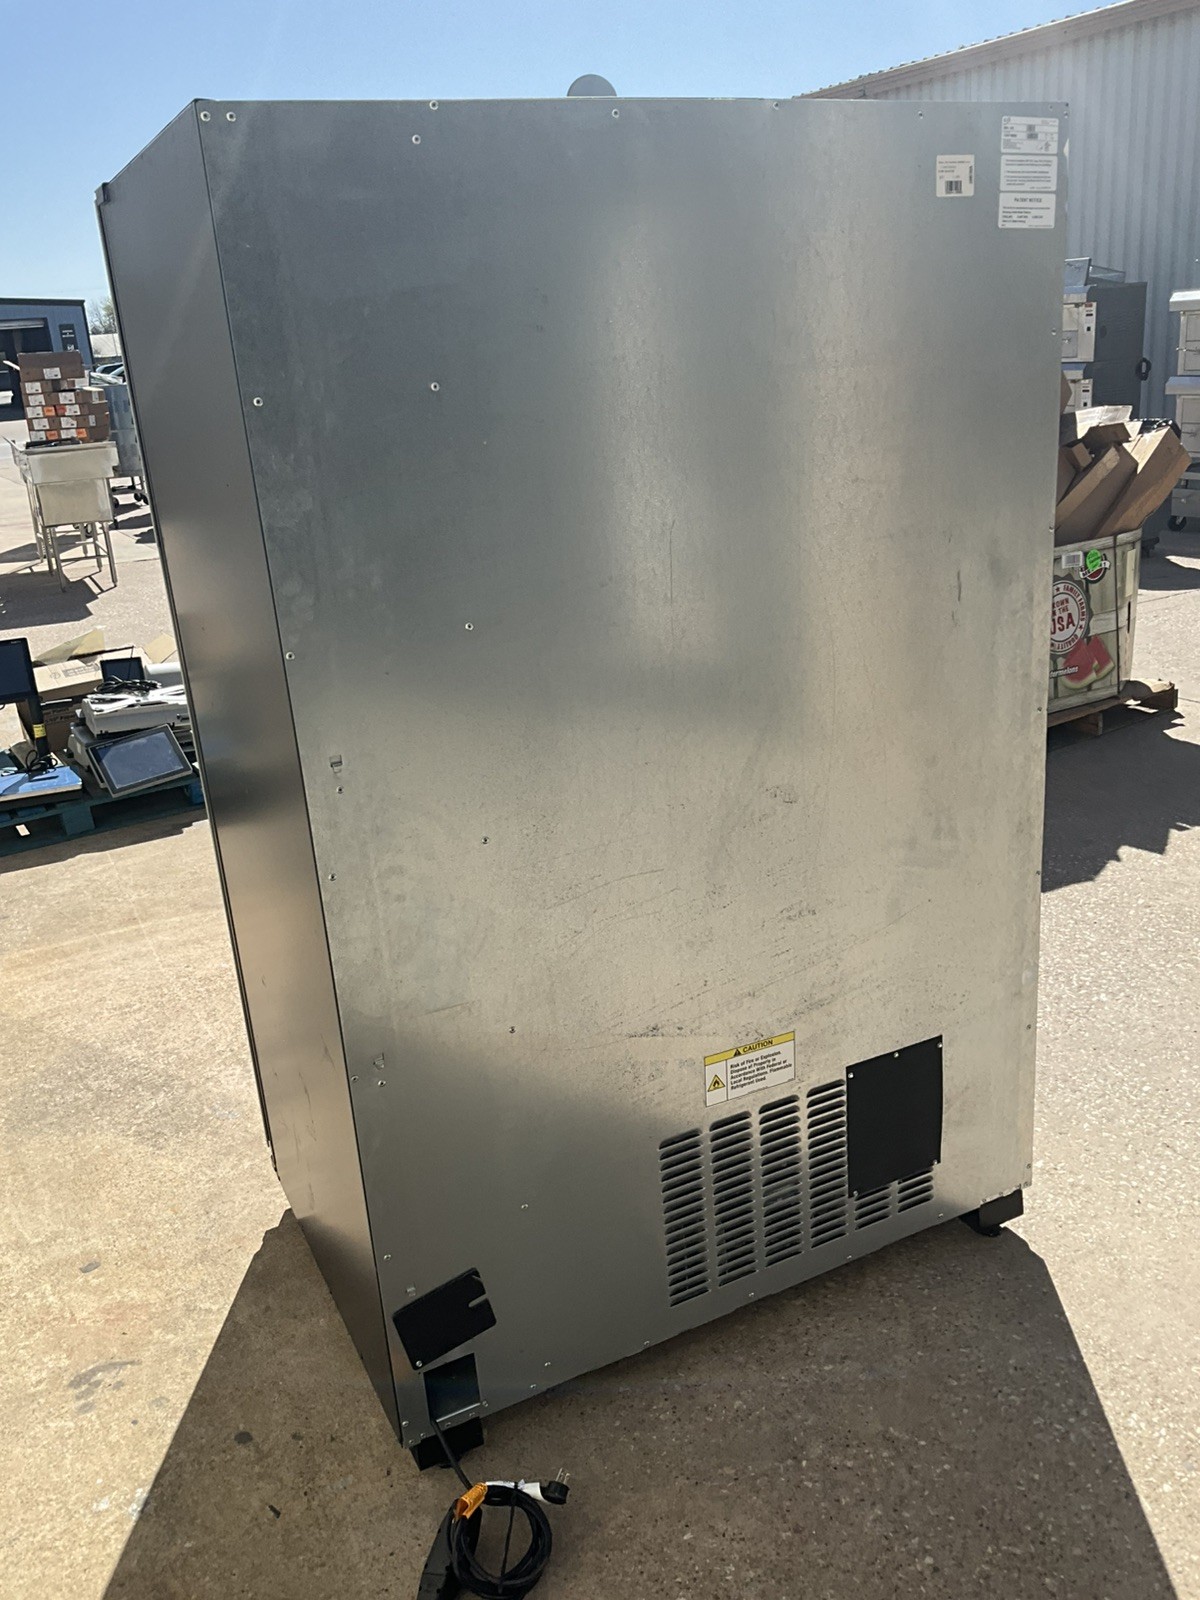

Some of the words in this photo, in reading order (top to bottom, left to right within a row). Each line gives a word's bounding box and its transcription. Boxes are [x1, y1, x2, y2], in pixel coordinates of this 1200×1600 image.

[1052, 597, 1069, 609] ROWN
[1063, 584, 1080, 599] FAMILY
[1078, 598, 1086, 621] FARMS
[1058, 605, 1069, 614] THE
[742, 1039, 774, 1053] CAUTION
[730, 1069, 756, 1080] Accordance
[766, 1060, 781, 1068] Federal
[730, 1066, 747, 1075] Dispose
[769, 1063, 792, 1073] Flammable
[730, 1079, 755, 1090] Refrigerant
